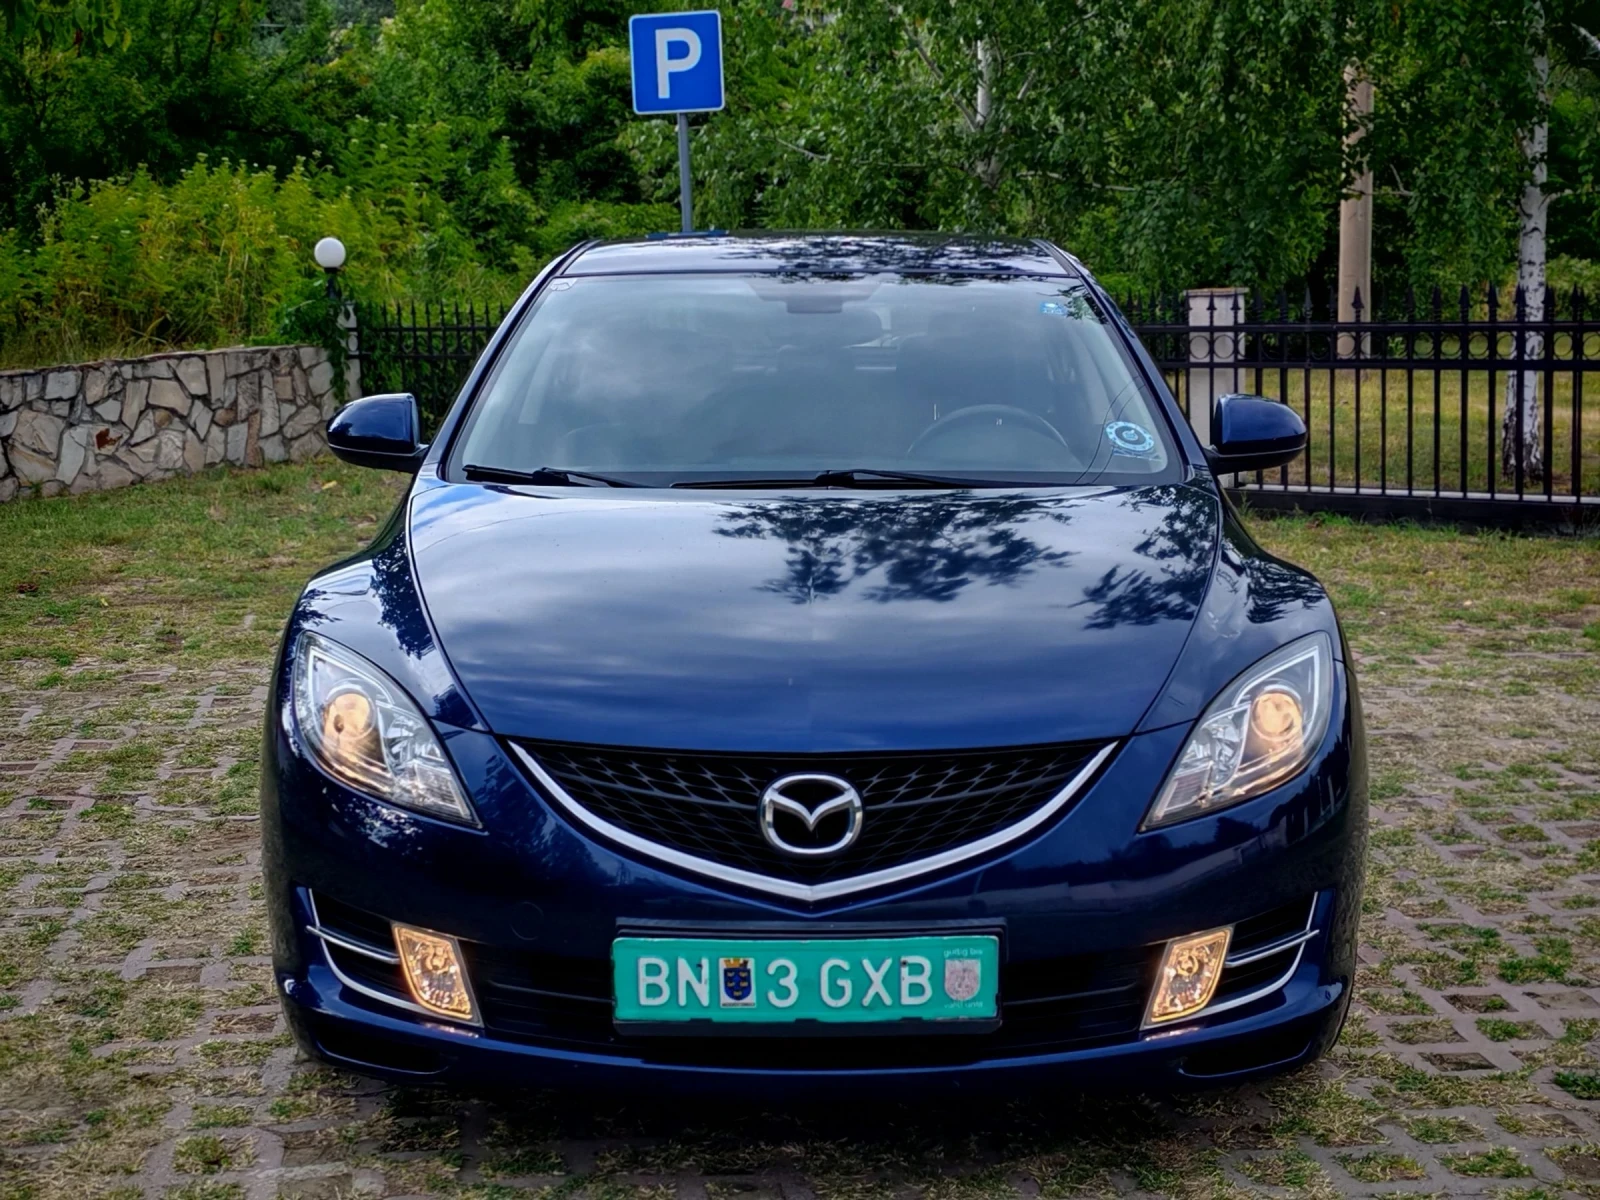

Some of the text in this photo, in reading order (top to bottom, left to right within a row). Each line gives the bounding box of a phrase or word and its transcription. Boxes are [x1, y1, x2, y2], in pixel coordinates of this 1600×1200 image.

[655, 27, 702, 99] P
[638, 955, 933, 1008] BN 3 GXB
